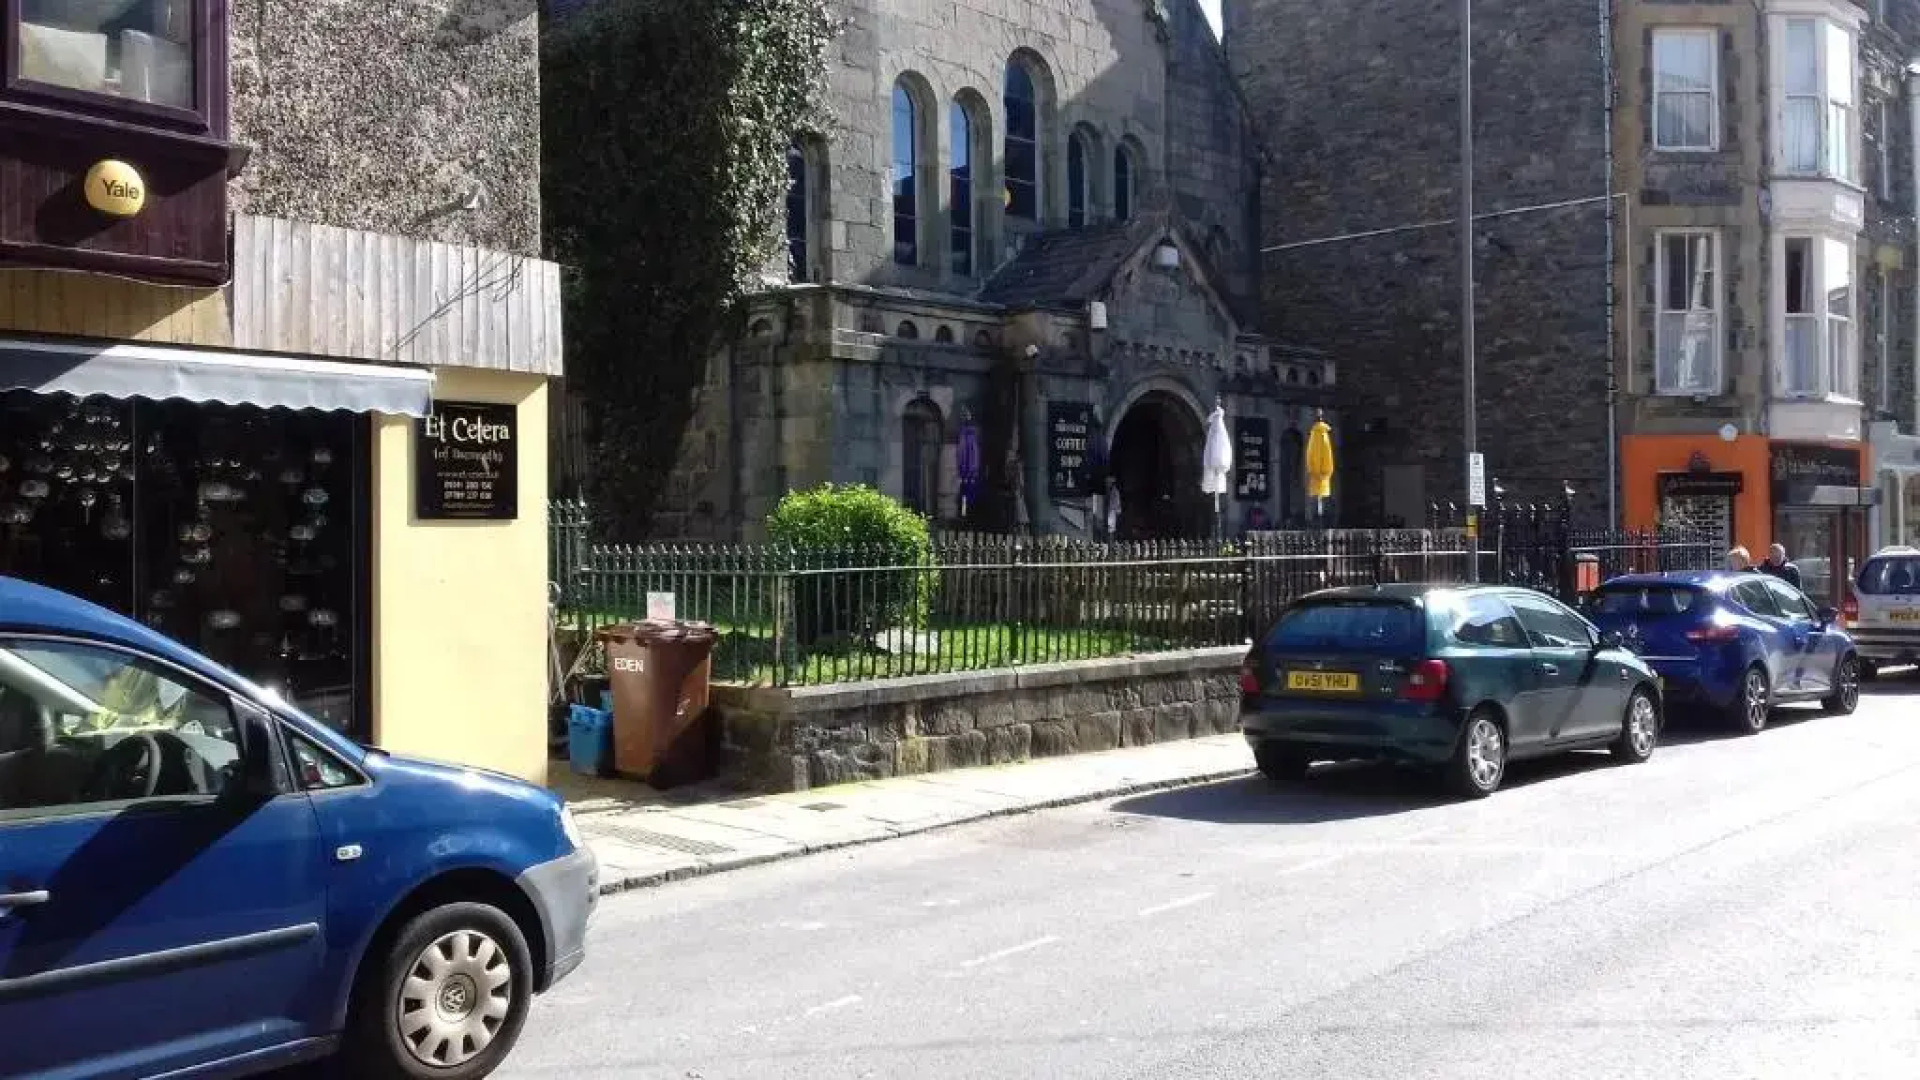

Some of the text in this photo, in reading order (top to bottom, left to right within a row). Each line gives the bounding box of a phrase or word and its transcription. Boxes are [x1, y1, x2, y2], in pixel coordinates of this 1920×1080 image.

[102, 178, 139, 199] Yale
[426, 413, 510, 444] Et Cetera
[1055, 437, 1086, 450] COFFEE
[614, 658, 644, 672] EDEN
